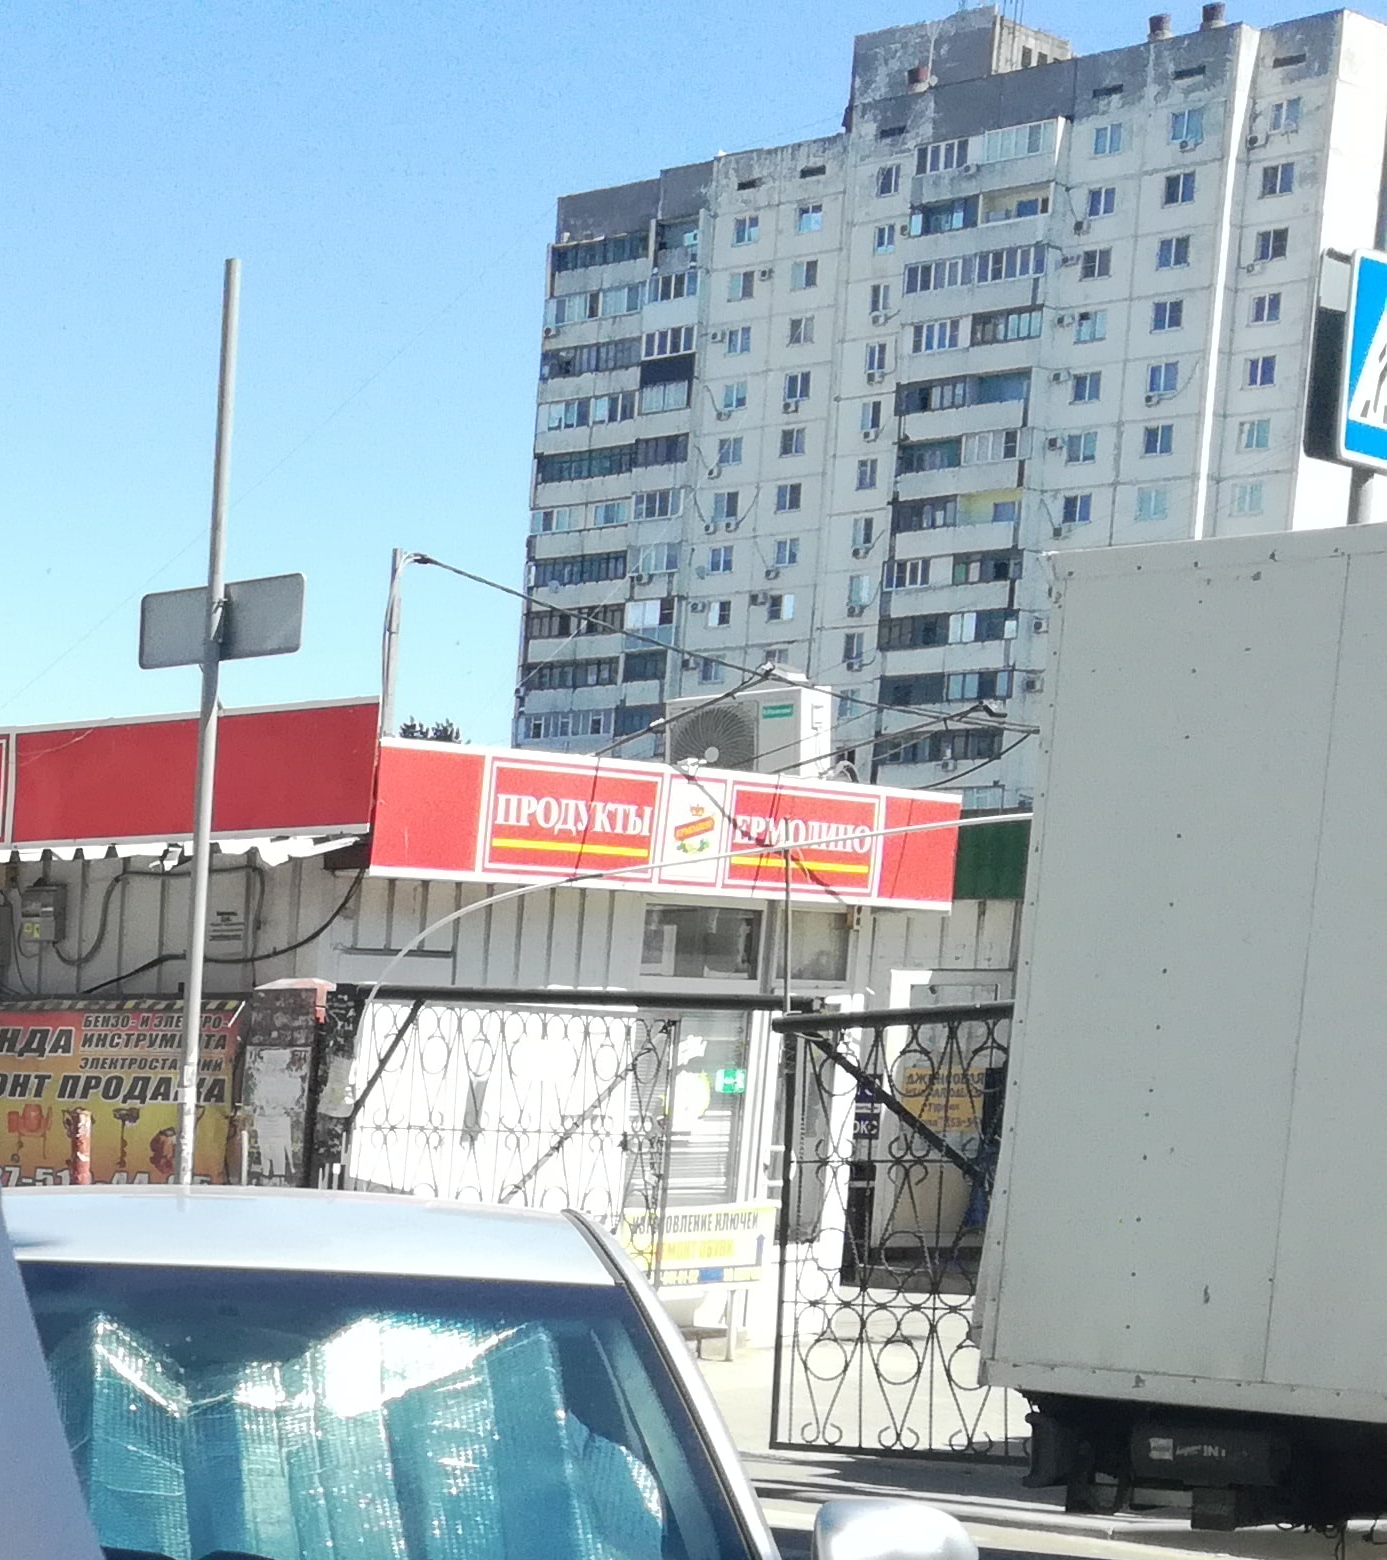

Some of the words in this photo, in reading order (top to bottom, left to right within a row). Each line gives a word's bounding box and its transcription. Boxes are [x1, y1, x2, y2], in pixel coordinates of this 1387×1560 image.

[494, 794, 653, 836] ПРОДУКТЫ
[733, 814, 872, 854] ЕРМОЛИНО
[153, 1014, 228, 1030] ЭЛЕРО-
[80, 1032, 227, 1050] ИНСТРУМТА
[79, 1056, 223, 1072] ЭЛЕКТРОСТАИЙ
